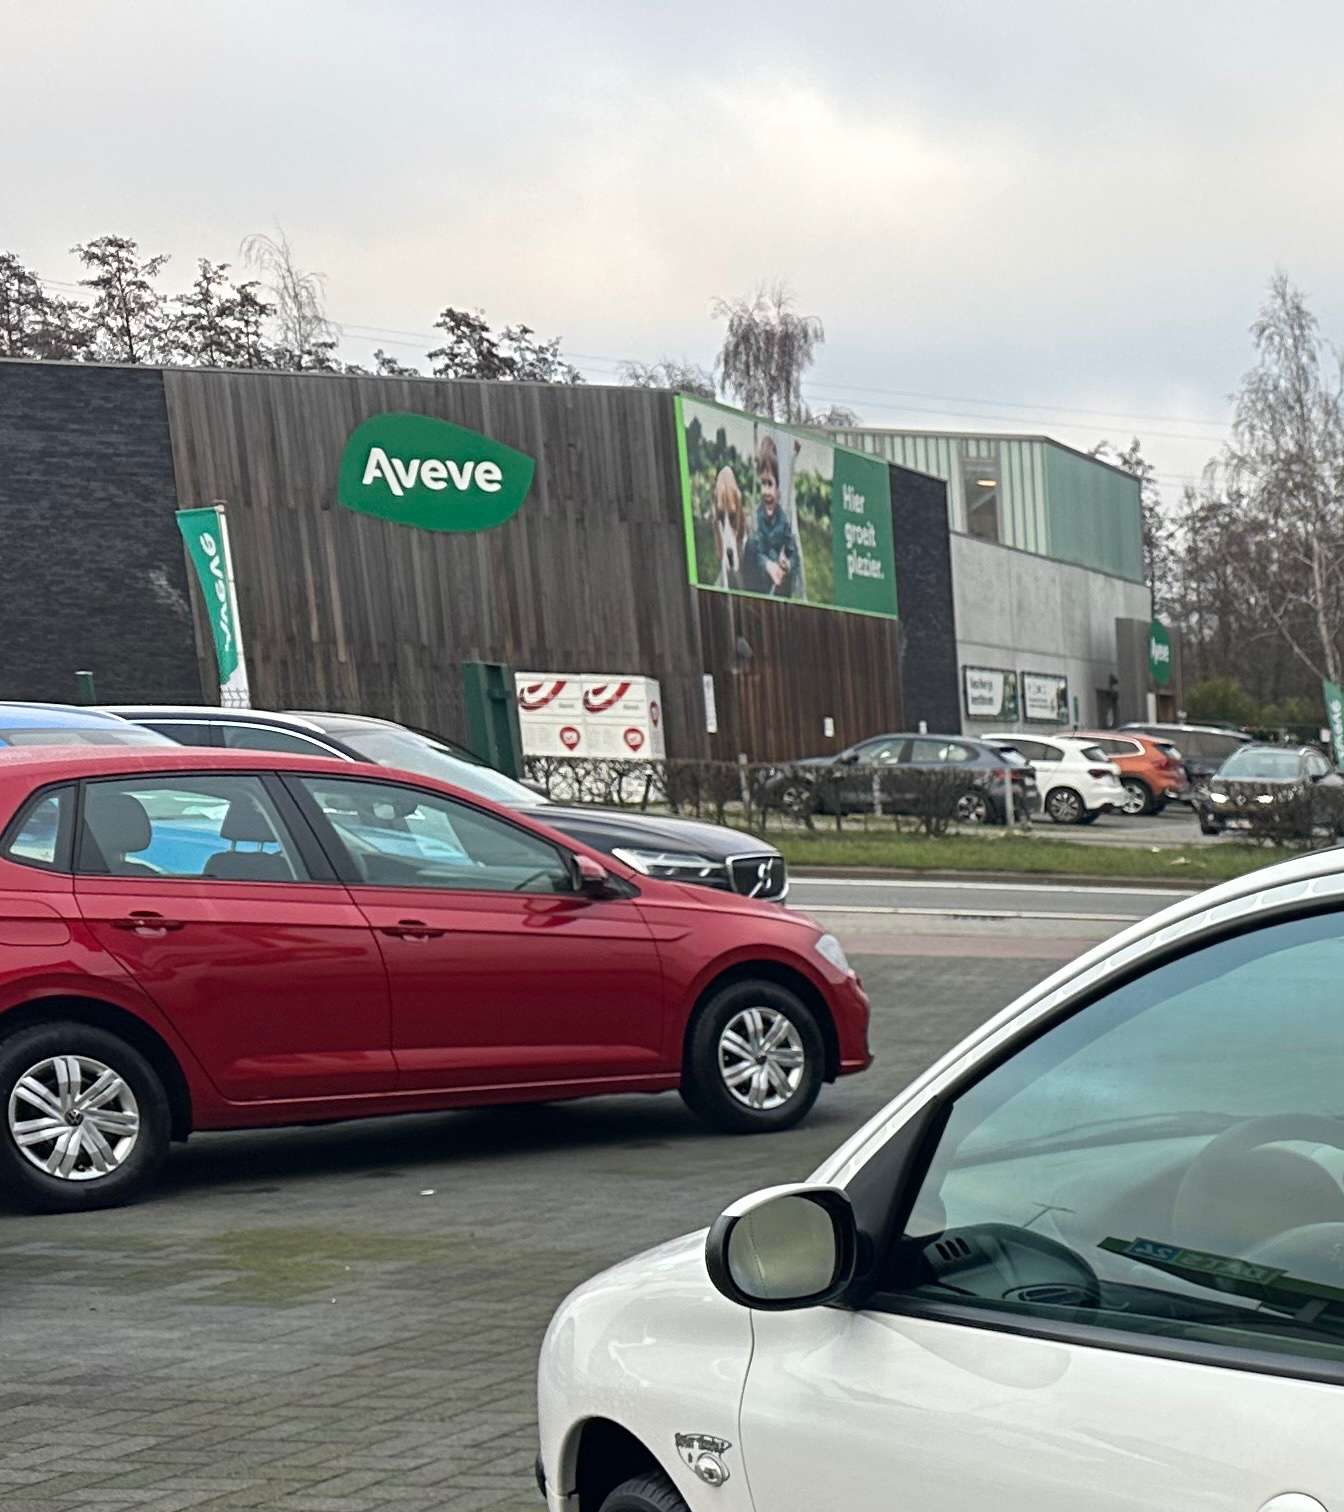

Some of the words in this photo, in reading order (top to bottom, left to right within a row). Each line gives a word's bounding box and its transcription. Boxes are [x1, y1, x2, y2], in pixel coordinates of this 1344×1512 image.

[362, 447, 503, 496] Aveve
[842, 484, 865, 513] Hier
[844, 521, 876, 549] groeit
